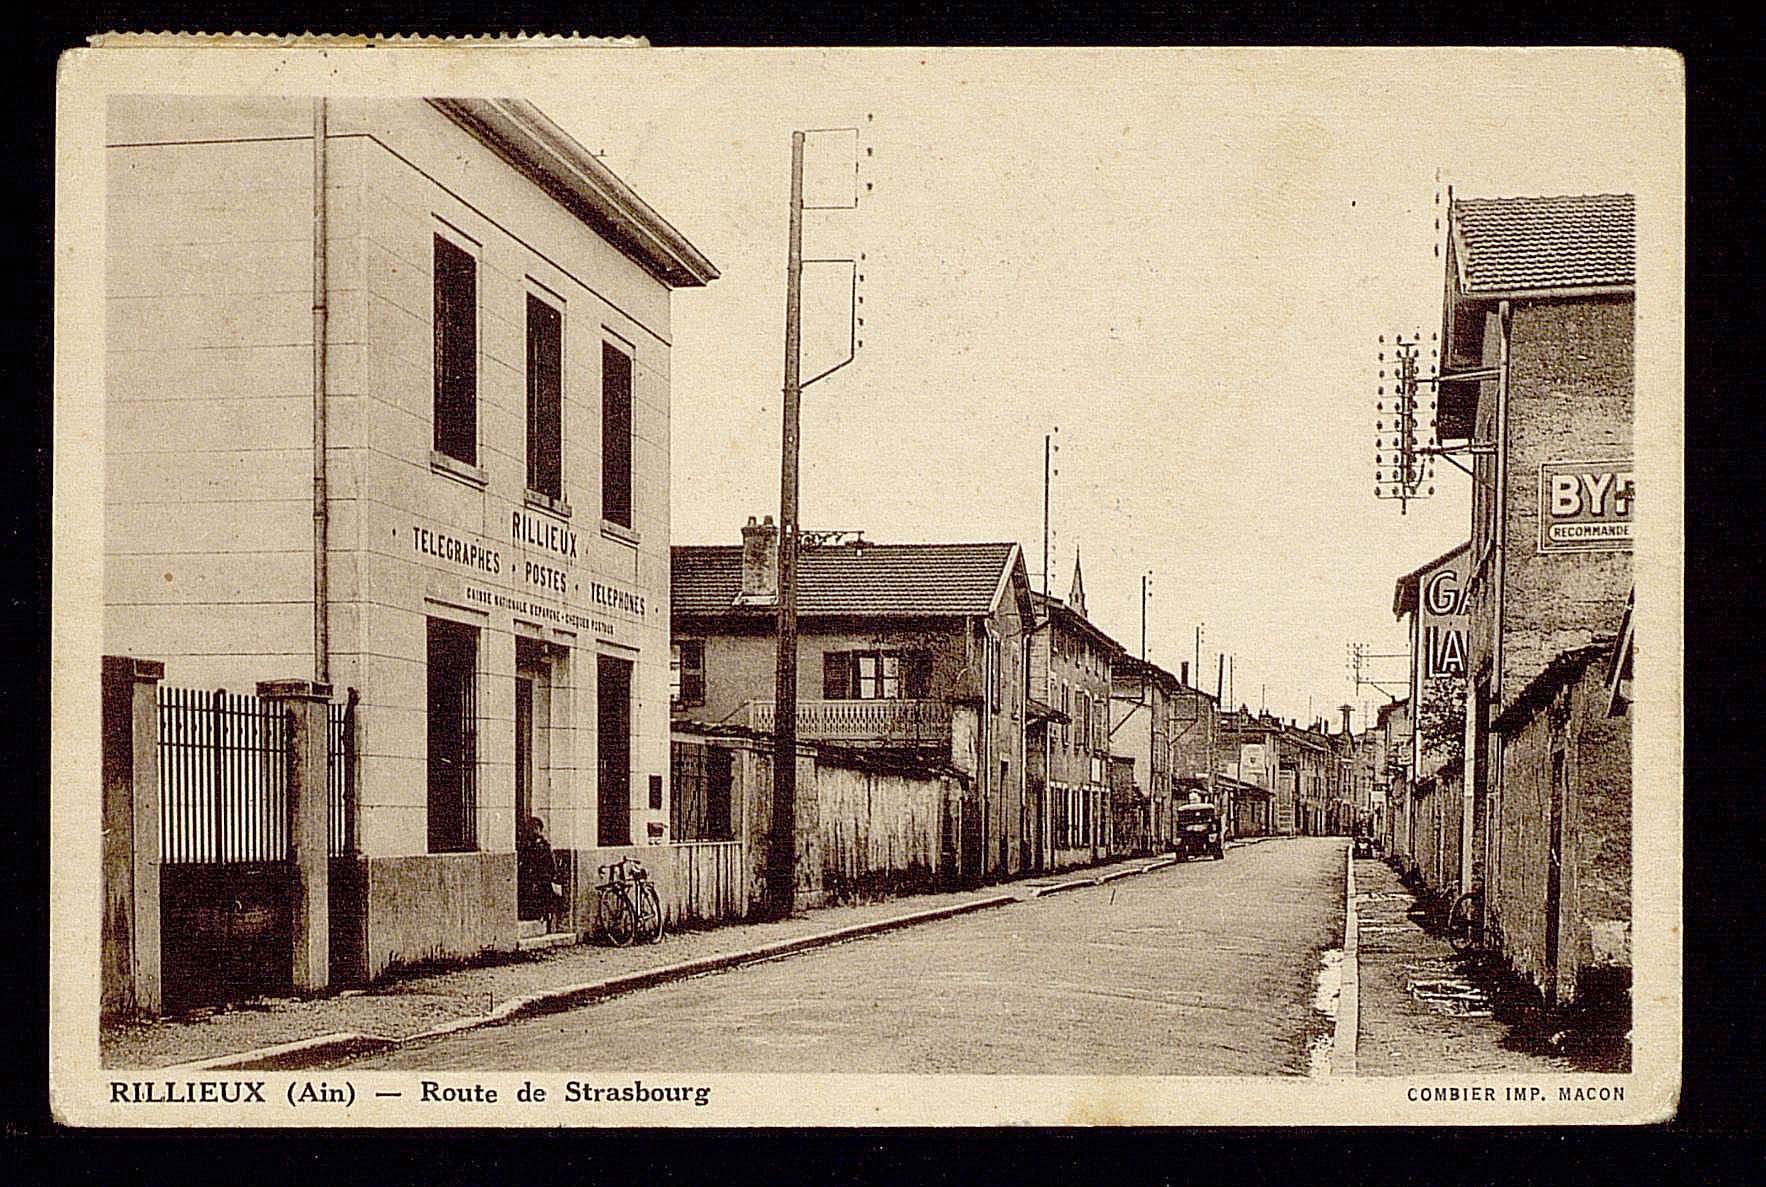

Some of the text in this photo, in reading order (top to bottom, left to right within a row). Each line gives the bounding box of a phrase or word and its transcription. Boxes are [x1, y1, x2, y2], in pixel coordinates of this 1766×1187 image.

[512, 511, 577, 558] RILLIEUX
[413, 526, 645, 616] TELEGRAPHES POSTES TELEPHONES
[1425, 626, 1470, 678] LA
